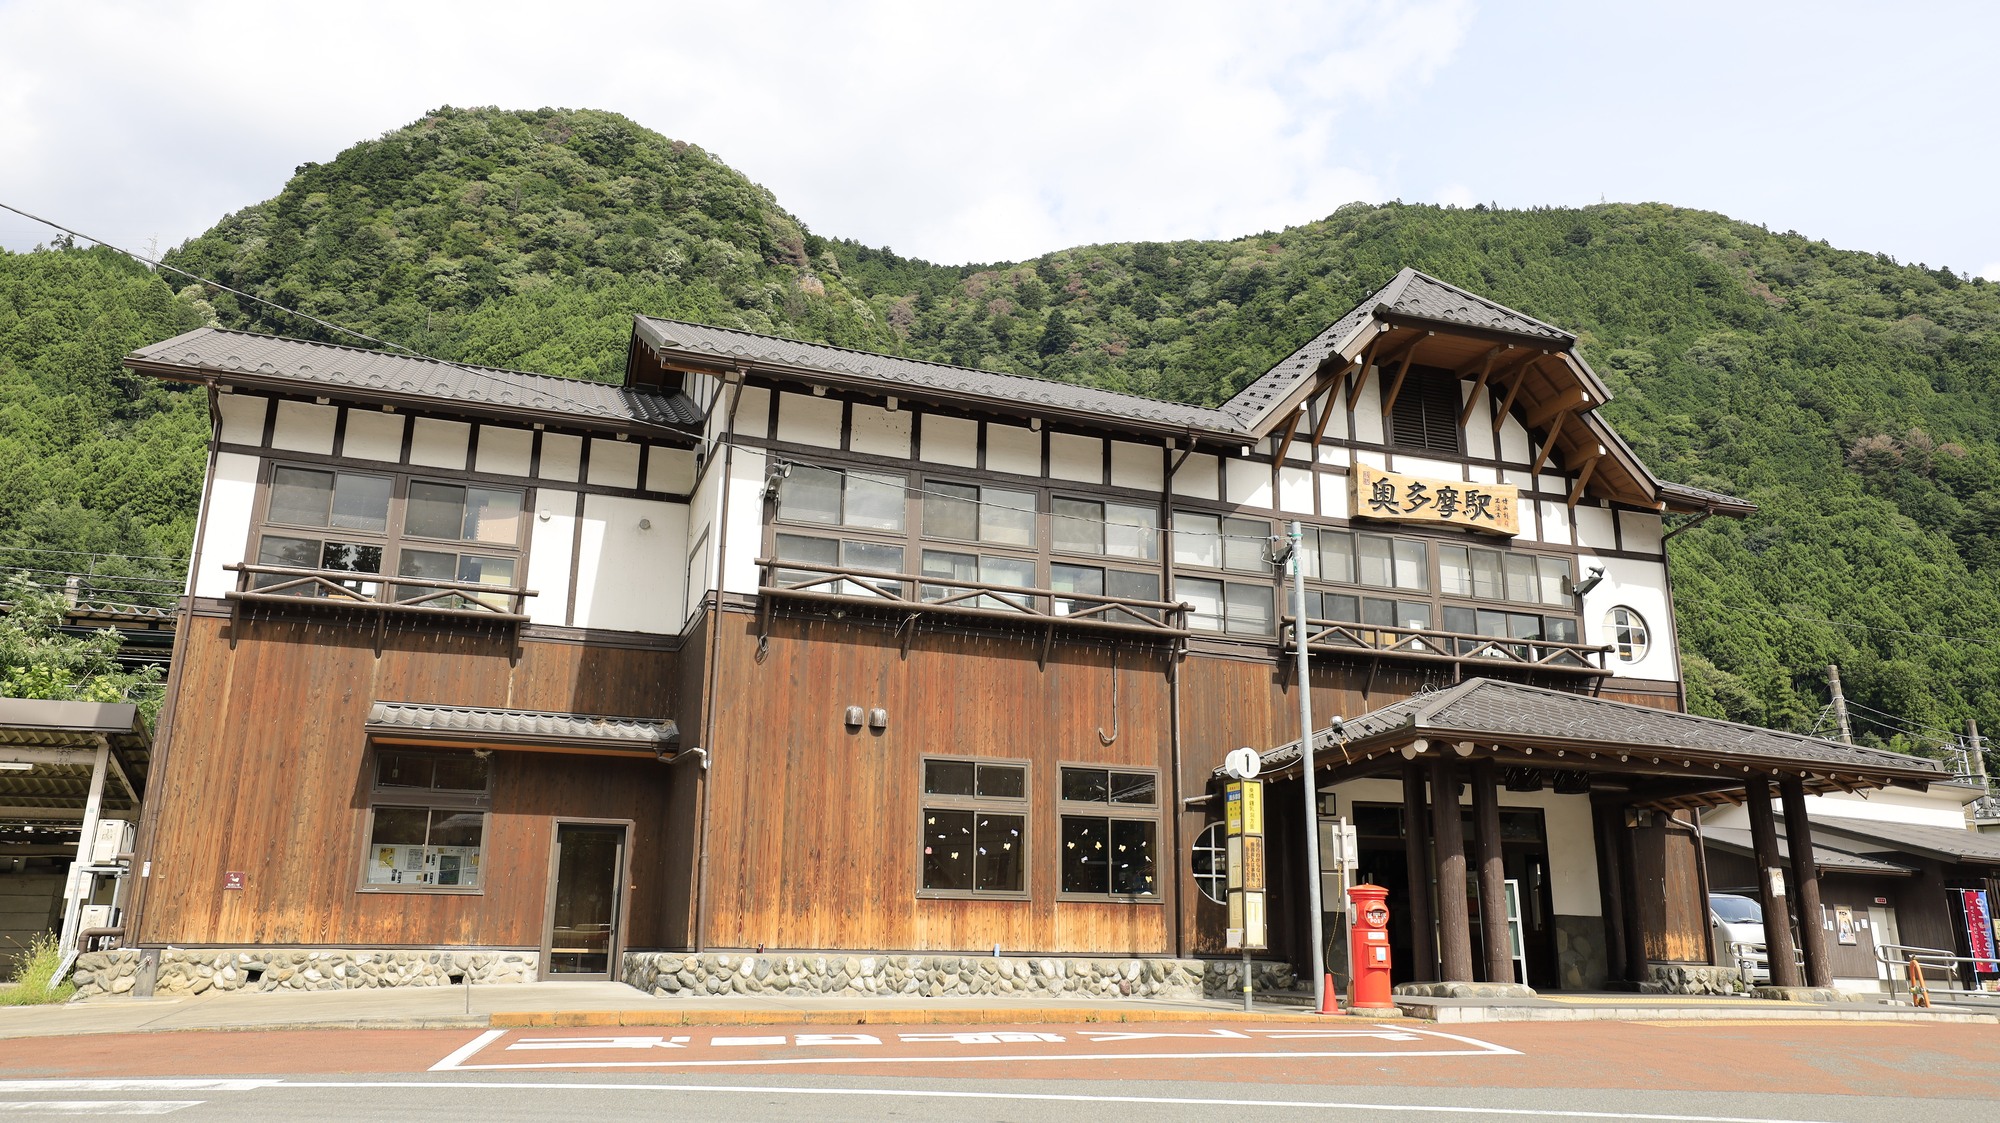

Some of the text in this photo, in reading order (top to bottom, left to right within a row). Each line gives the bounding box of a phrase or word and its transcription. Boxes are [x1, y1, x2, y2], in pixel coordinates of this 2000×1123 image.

[1368, 477, 1495, 521] 奥多摩駅
[1244, 753, 1250, 772] 1
